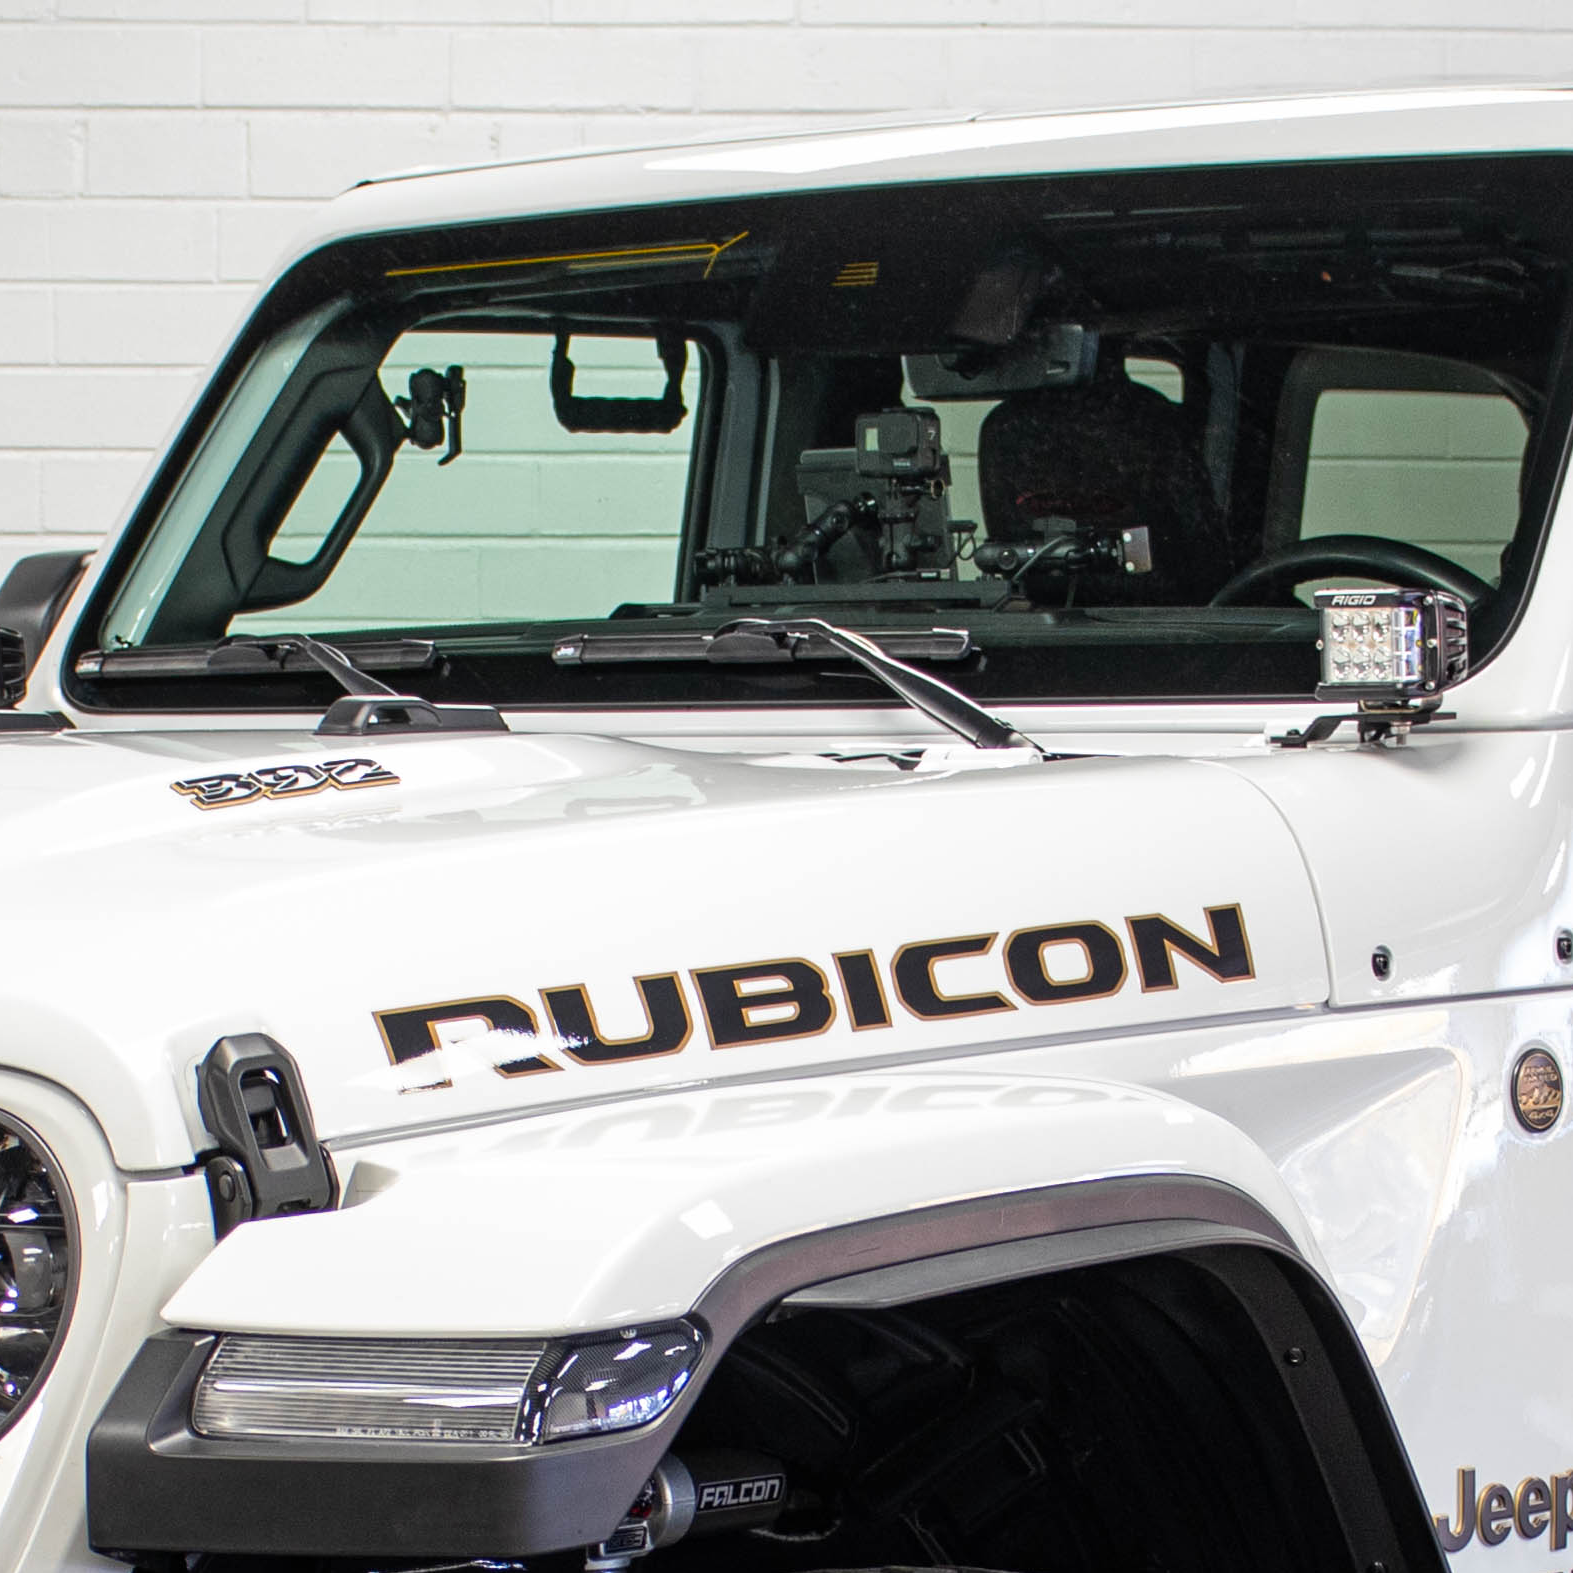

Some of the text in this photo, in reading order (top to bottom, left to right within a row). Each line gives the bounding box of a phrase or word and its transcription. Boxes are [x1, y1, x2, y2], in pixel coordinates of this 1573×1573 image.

[1331, 595, 1377, 606] RIGID
[170, 758, 402, 811] 392
[372, 902, 1255, 1092] RUBICON
[700, 1479, 780, 1509] FALCON
